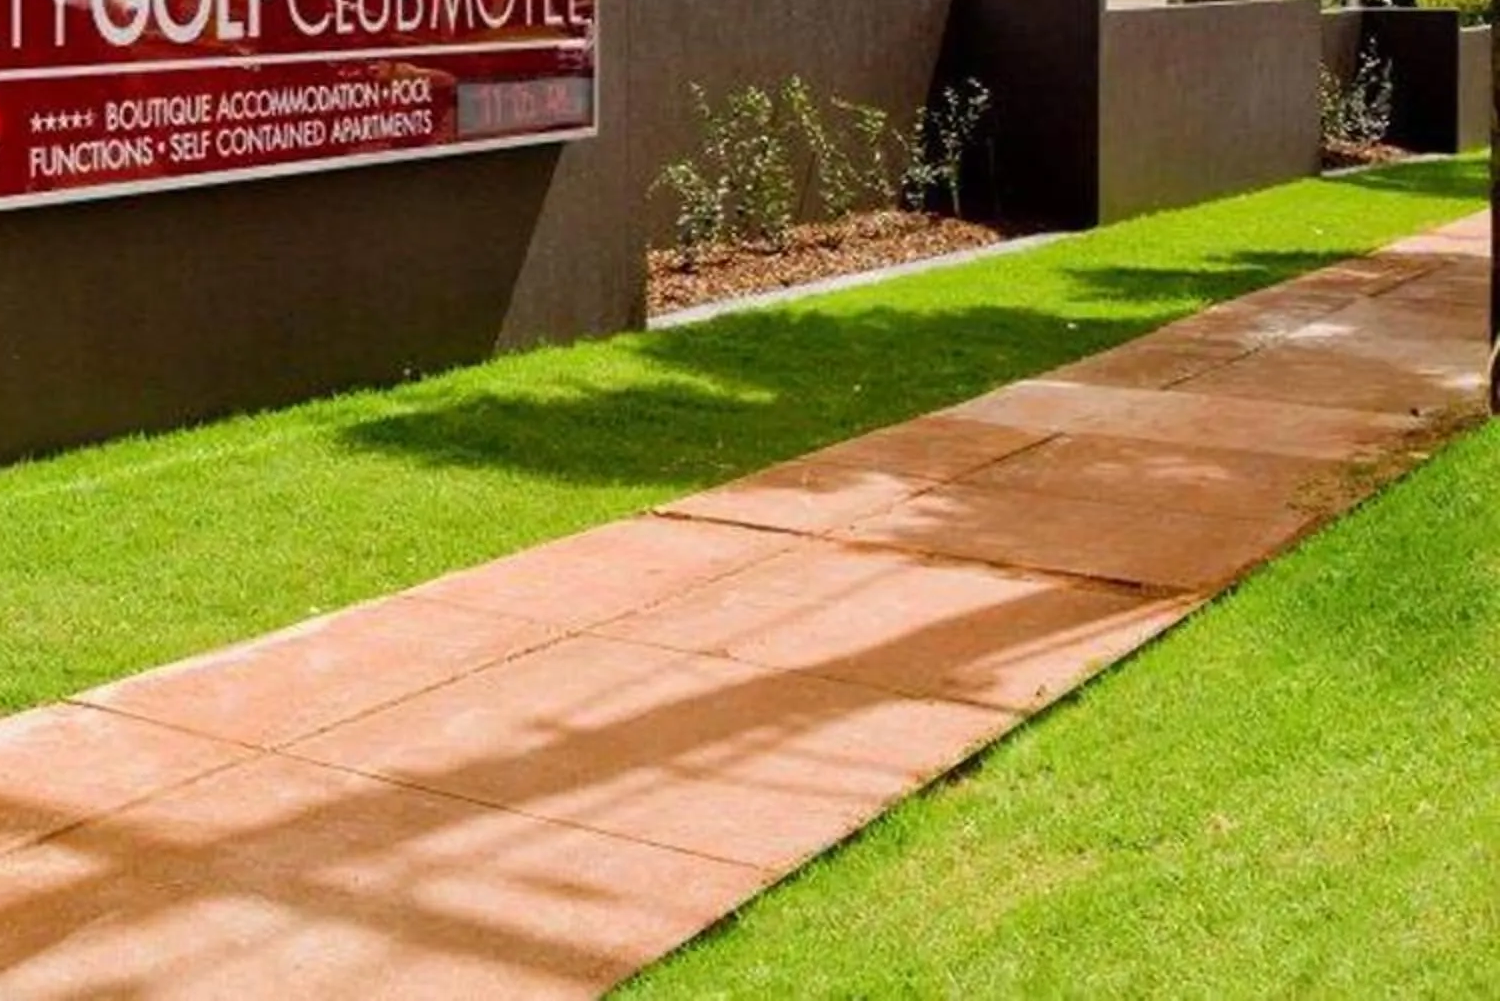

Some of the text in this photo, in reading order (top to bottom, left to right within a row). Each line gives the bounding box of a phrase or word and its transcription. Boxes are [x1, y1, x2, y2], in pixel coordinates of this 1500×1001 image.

[105, 94, 212, 132] BOUTIQUE
[216, 82, 380, 122] ACCOMMODATION
[29, 108, 433, 179] FUNCTIONS SELF CONTAINED APARTMENTS
